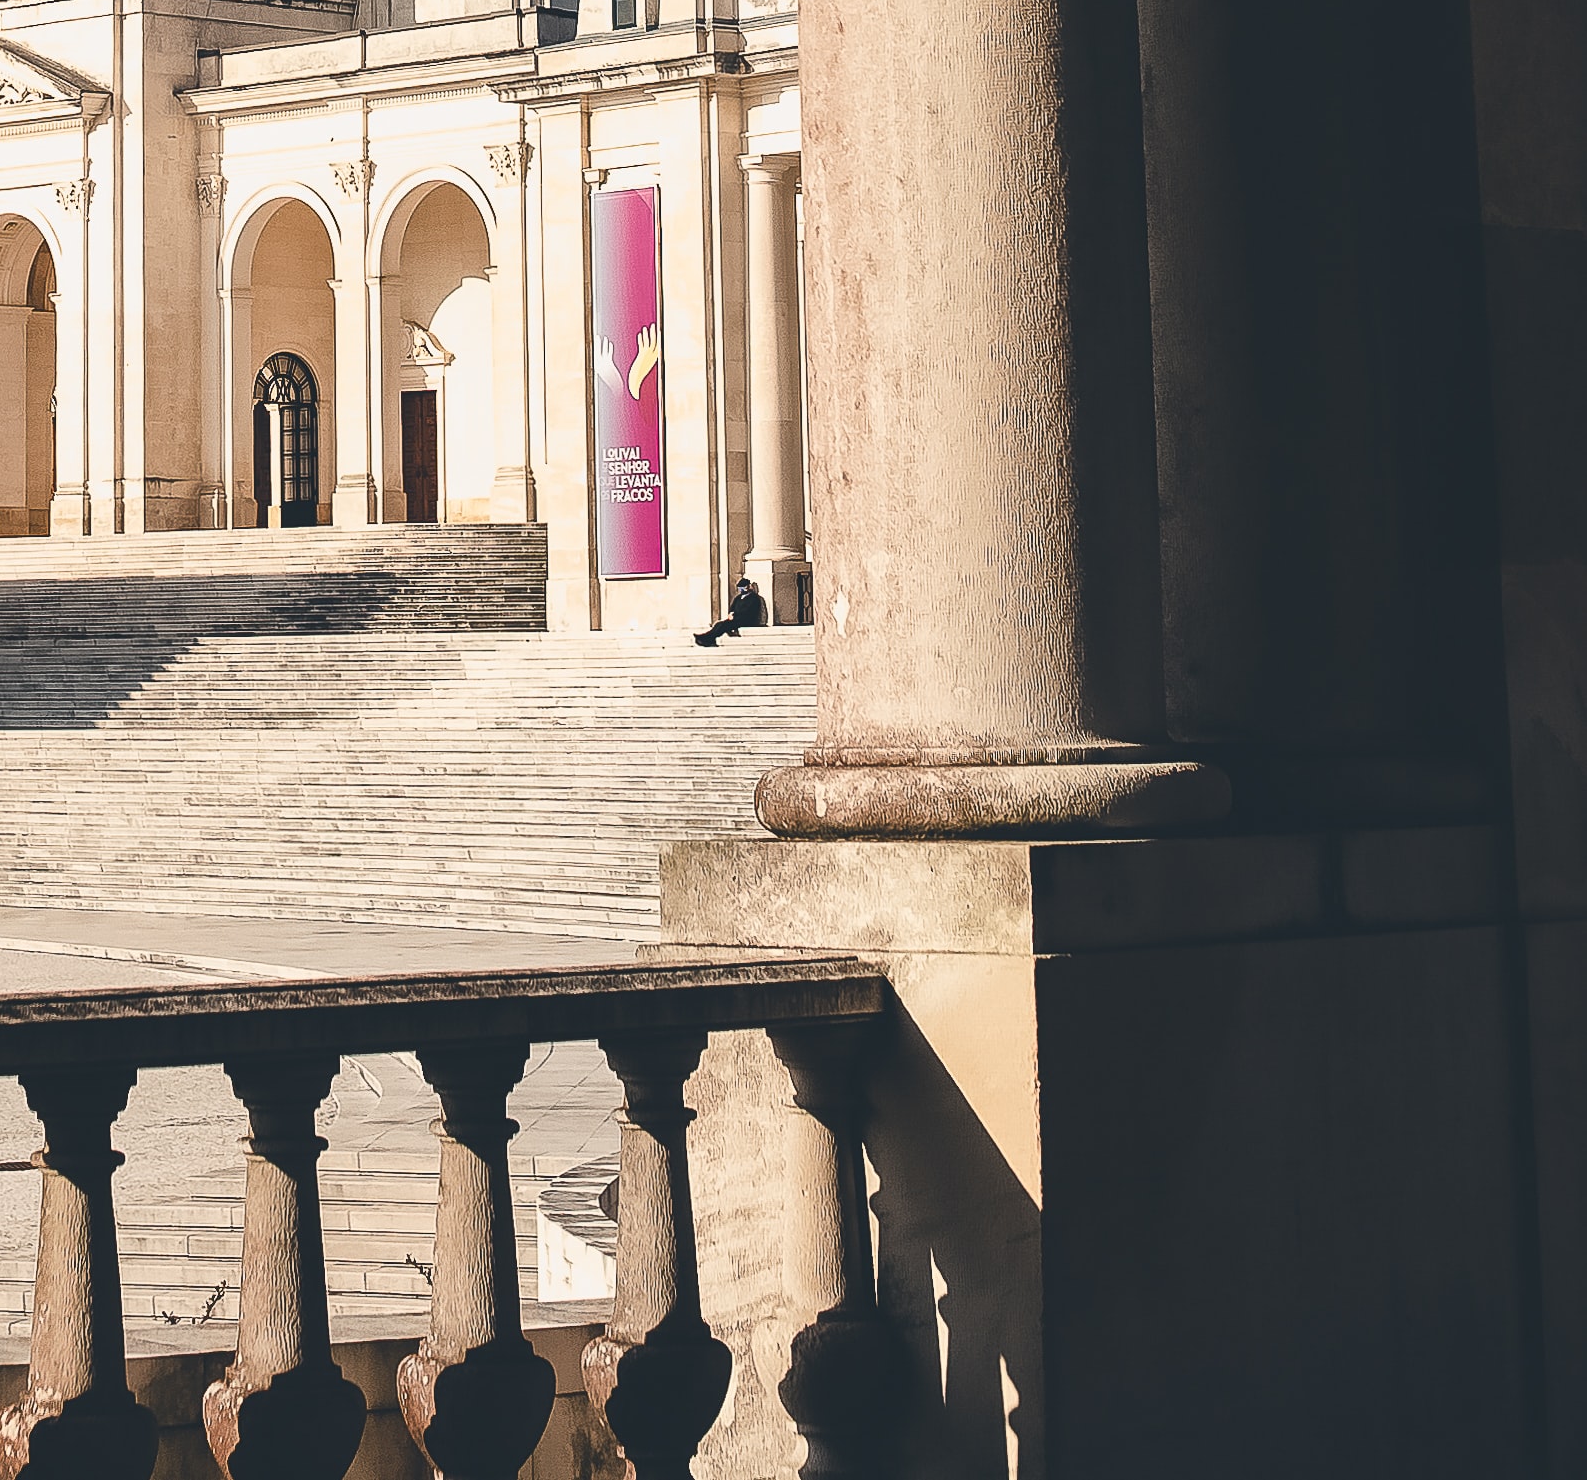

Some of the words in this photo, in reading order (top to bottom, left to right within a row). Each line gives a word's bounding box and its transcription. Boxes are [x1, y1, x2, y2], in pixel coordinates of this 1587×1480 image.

[603, 446, 640, 461] LOUVAI
[608, 460, 650, 475] SENHOR
[616, 474, 661, 489] LEVANTA
[611, 488, 654, 503] FRACOS
